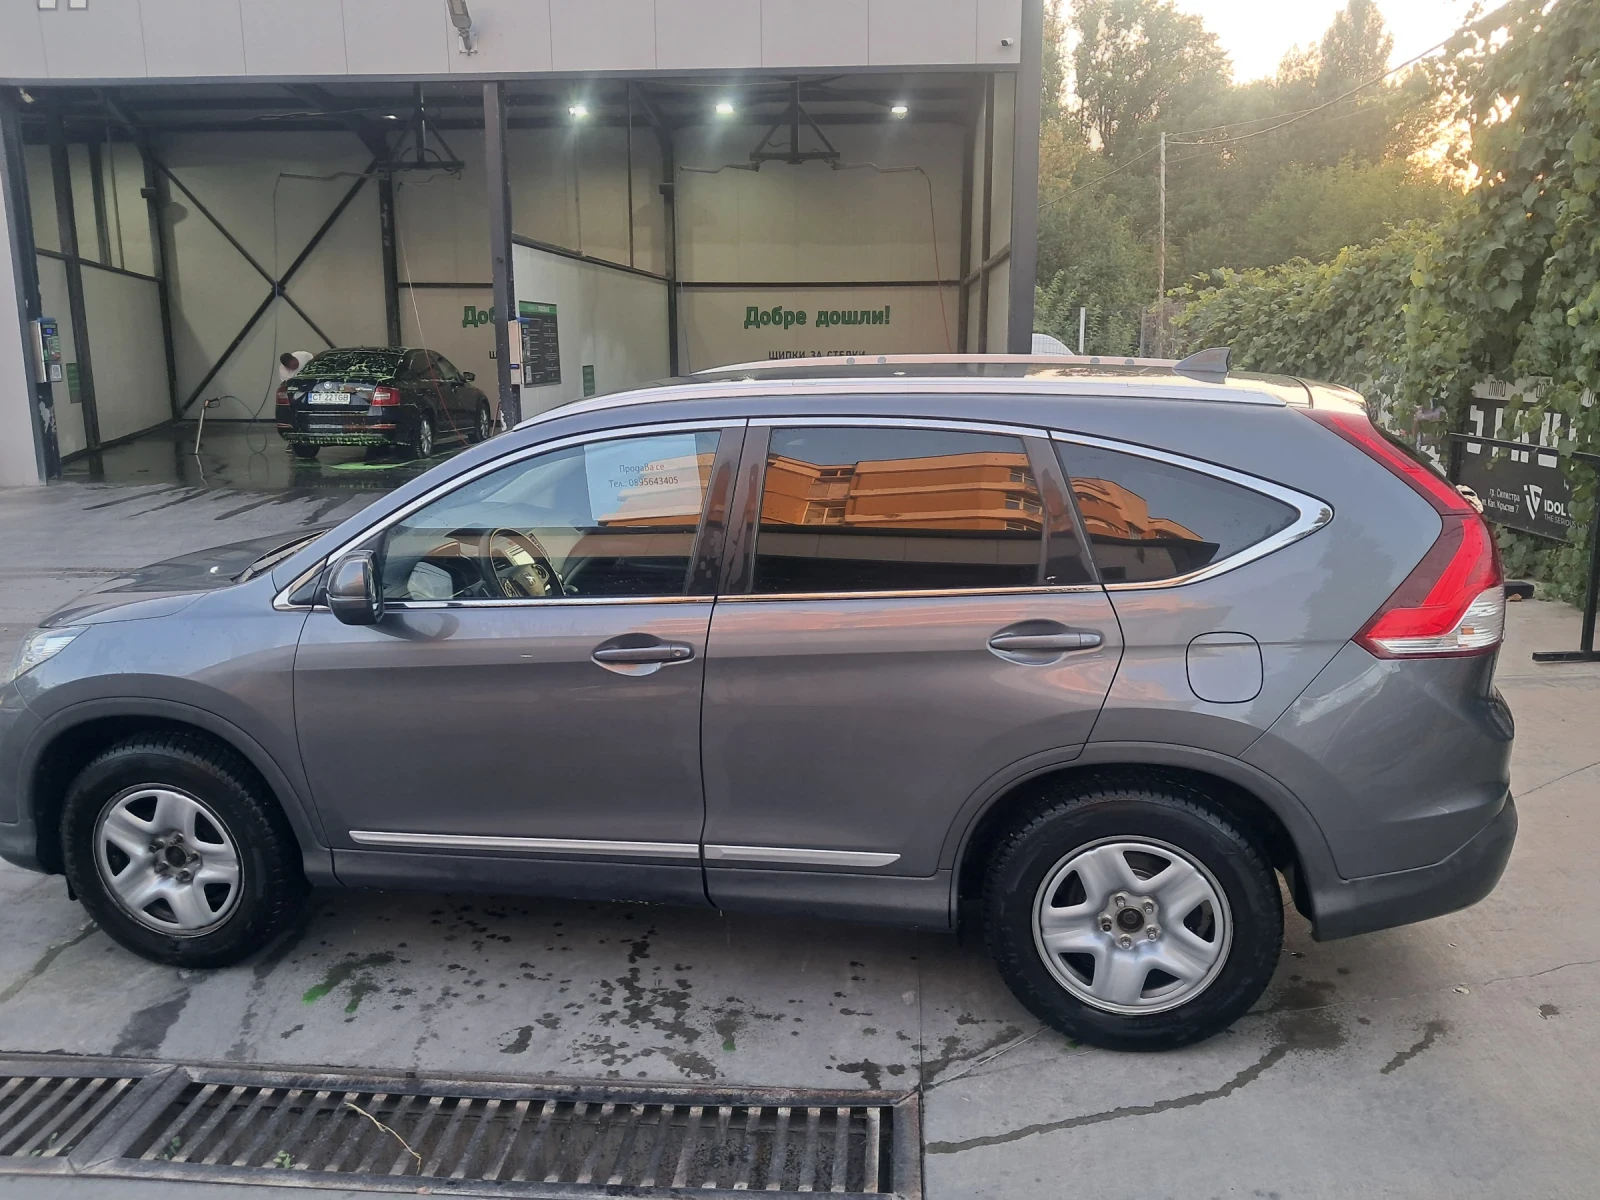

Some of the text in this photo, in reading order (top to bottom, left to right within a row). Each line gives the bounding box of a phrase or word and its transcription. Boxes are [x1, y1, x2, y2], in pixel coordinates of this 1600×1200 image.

[743, 305, 891, 330] Добре дошли!
[619, 463, 654, 474] Продава
[628, 476, 679, 487] 0895643405
[1543, 499, 1567, 516] IDOL
[1543, 513, 1554, 523] THE
[1554, 516, 1577, 529] SERIOUS
